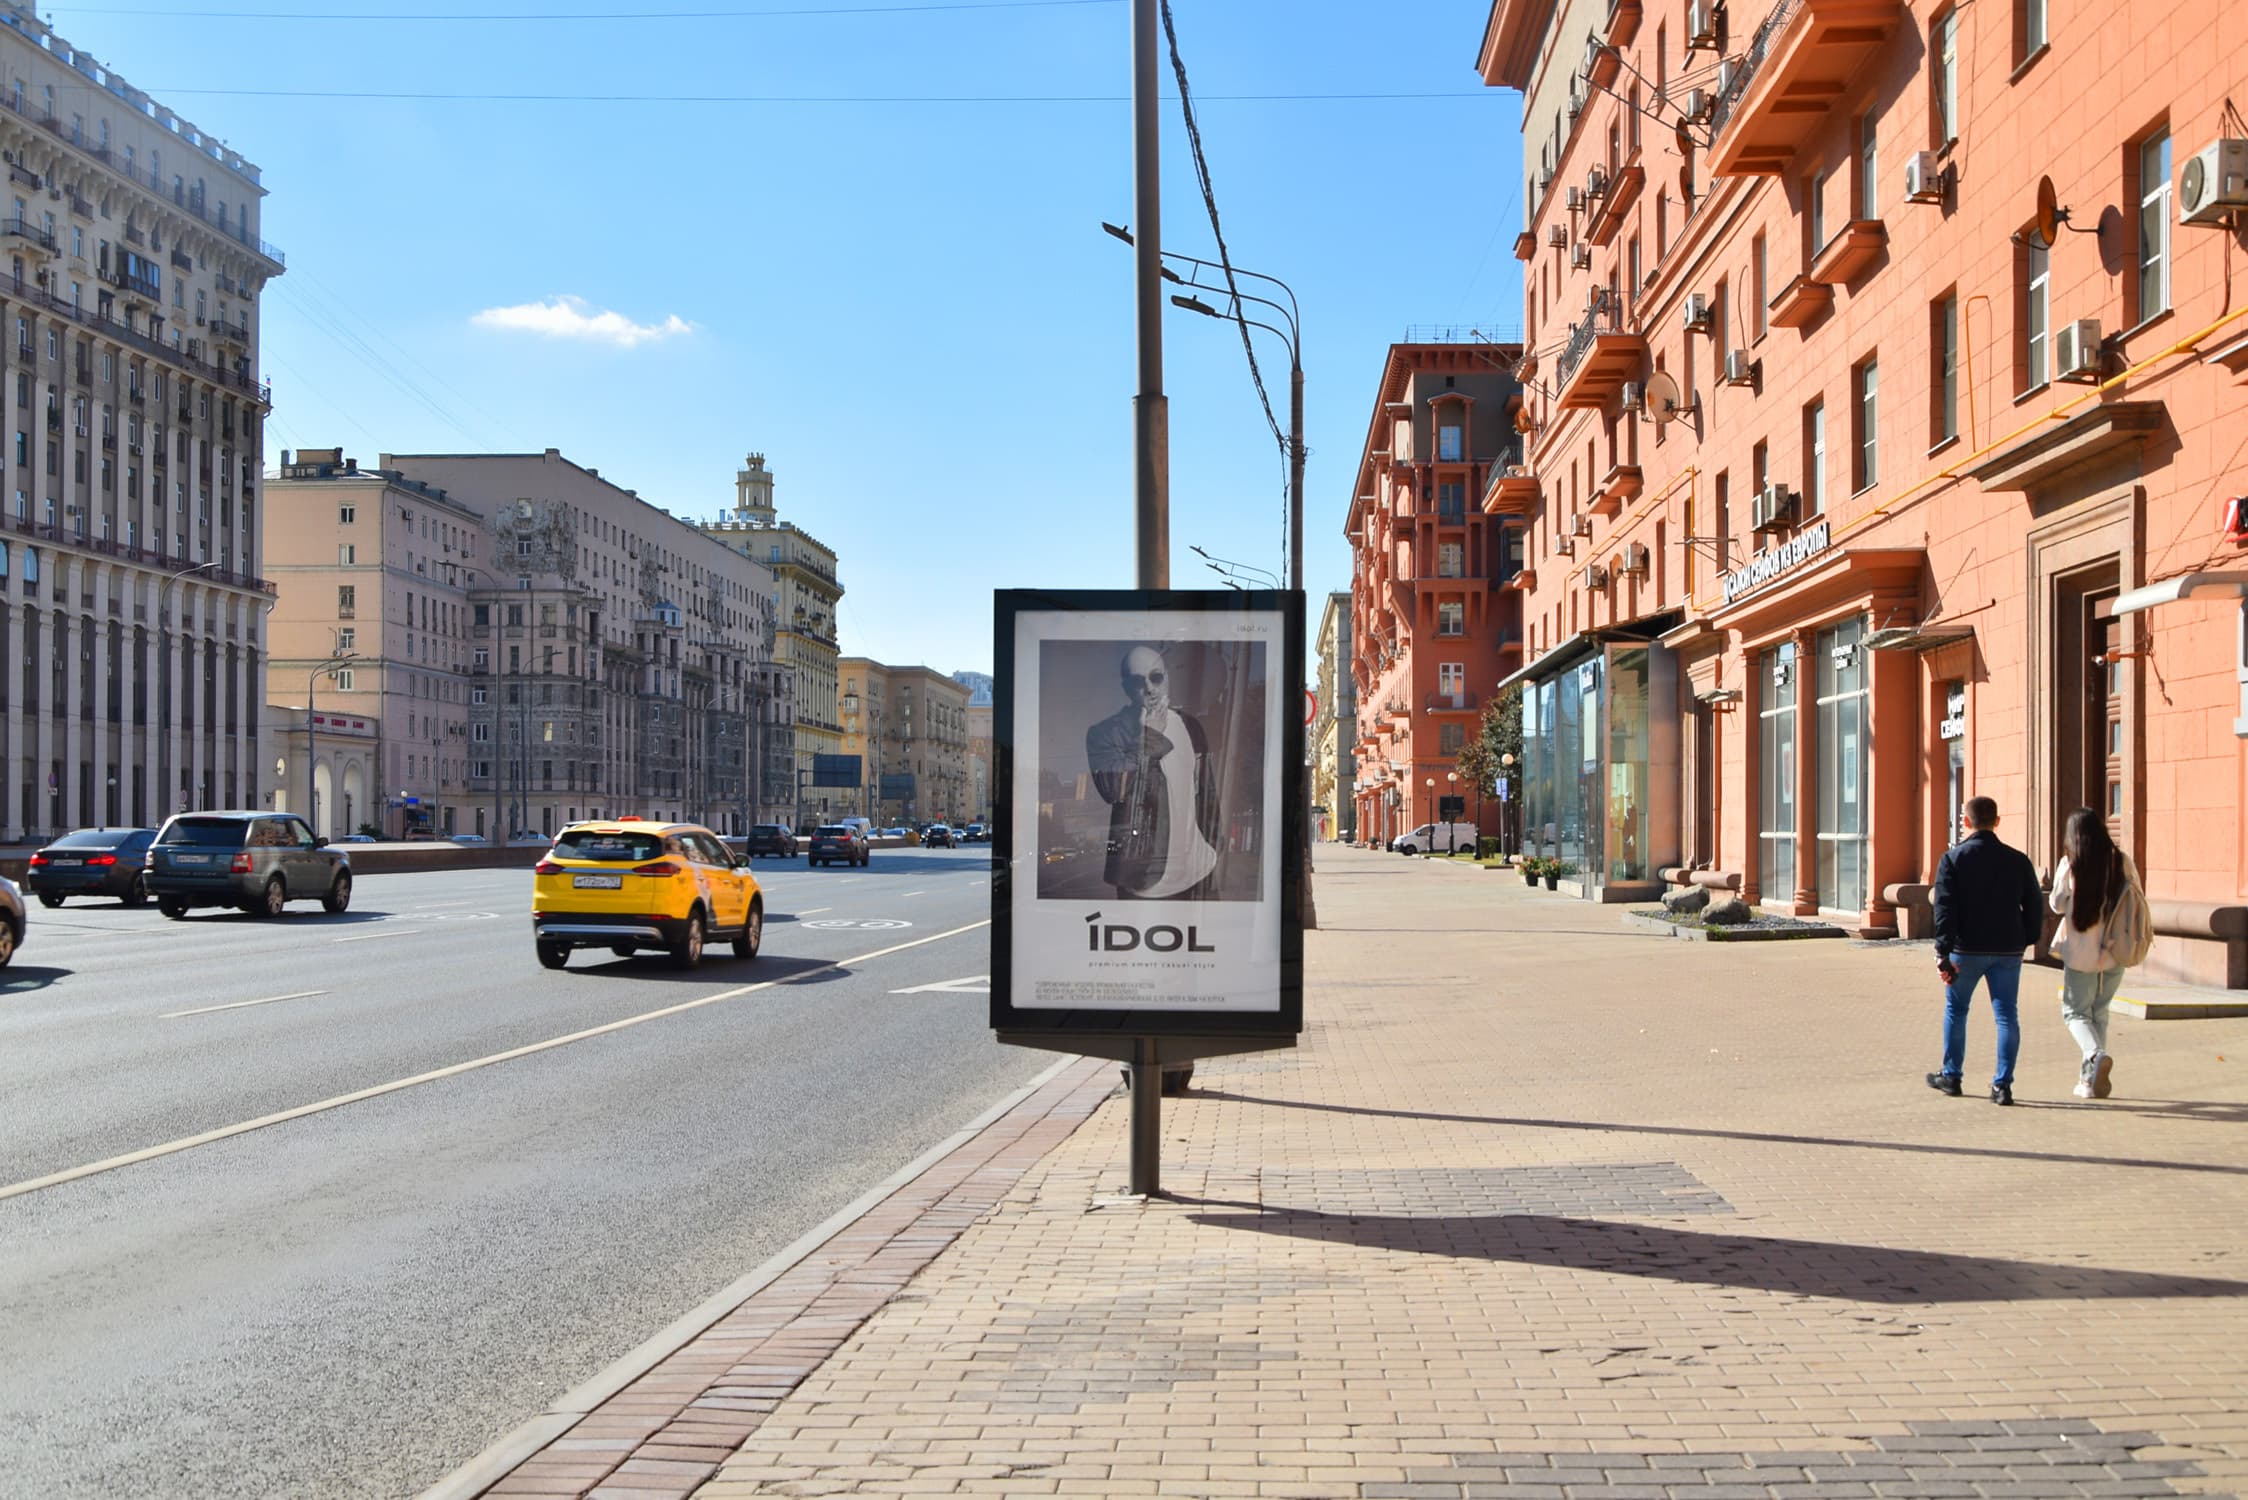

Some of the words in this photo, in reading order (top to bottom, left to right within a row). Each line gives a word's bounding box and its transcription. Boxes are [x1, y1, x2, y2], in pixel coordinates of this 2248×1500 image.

[1728, 565, 1751, 597] САЛОН
[1750, 551, 1781, 584] СЕЙФОВ
[1780, 544, 1792, 569] ИЗ
[1792, 522, 1828, 562] ЕВРОПЫ
